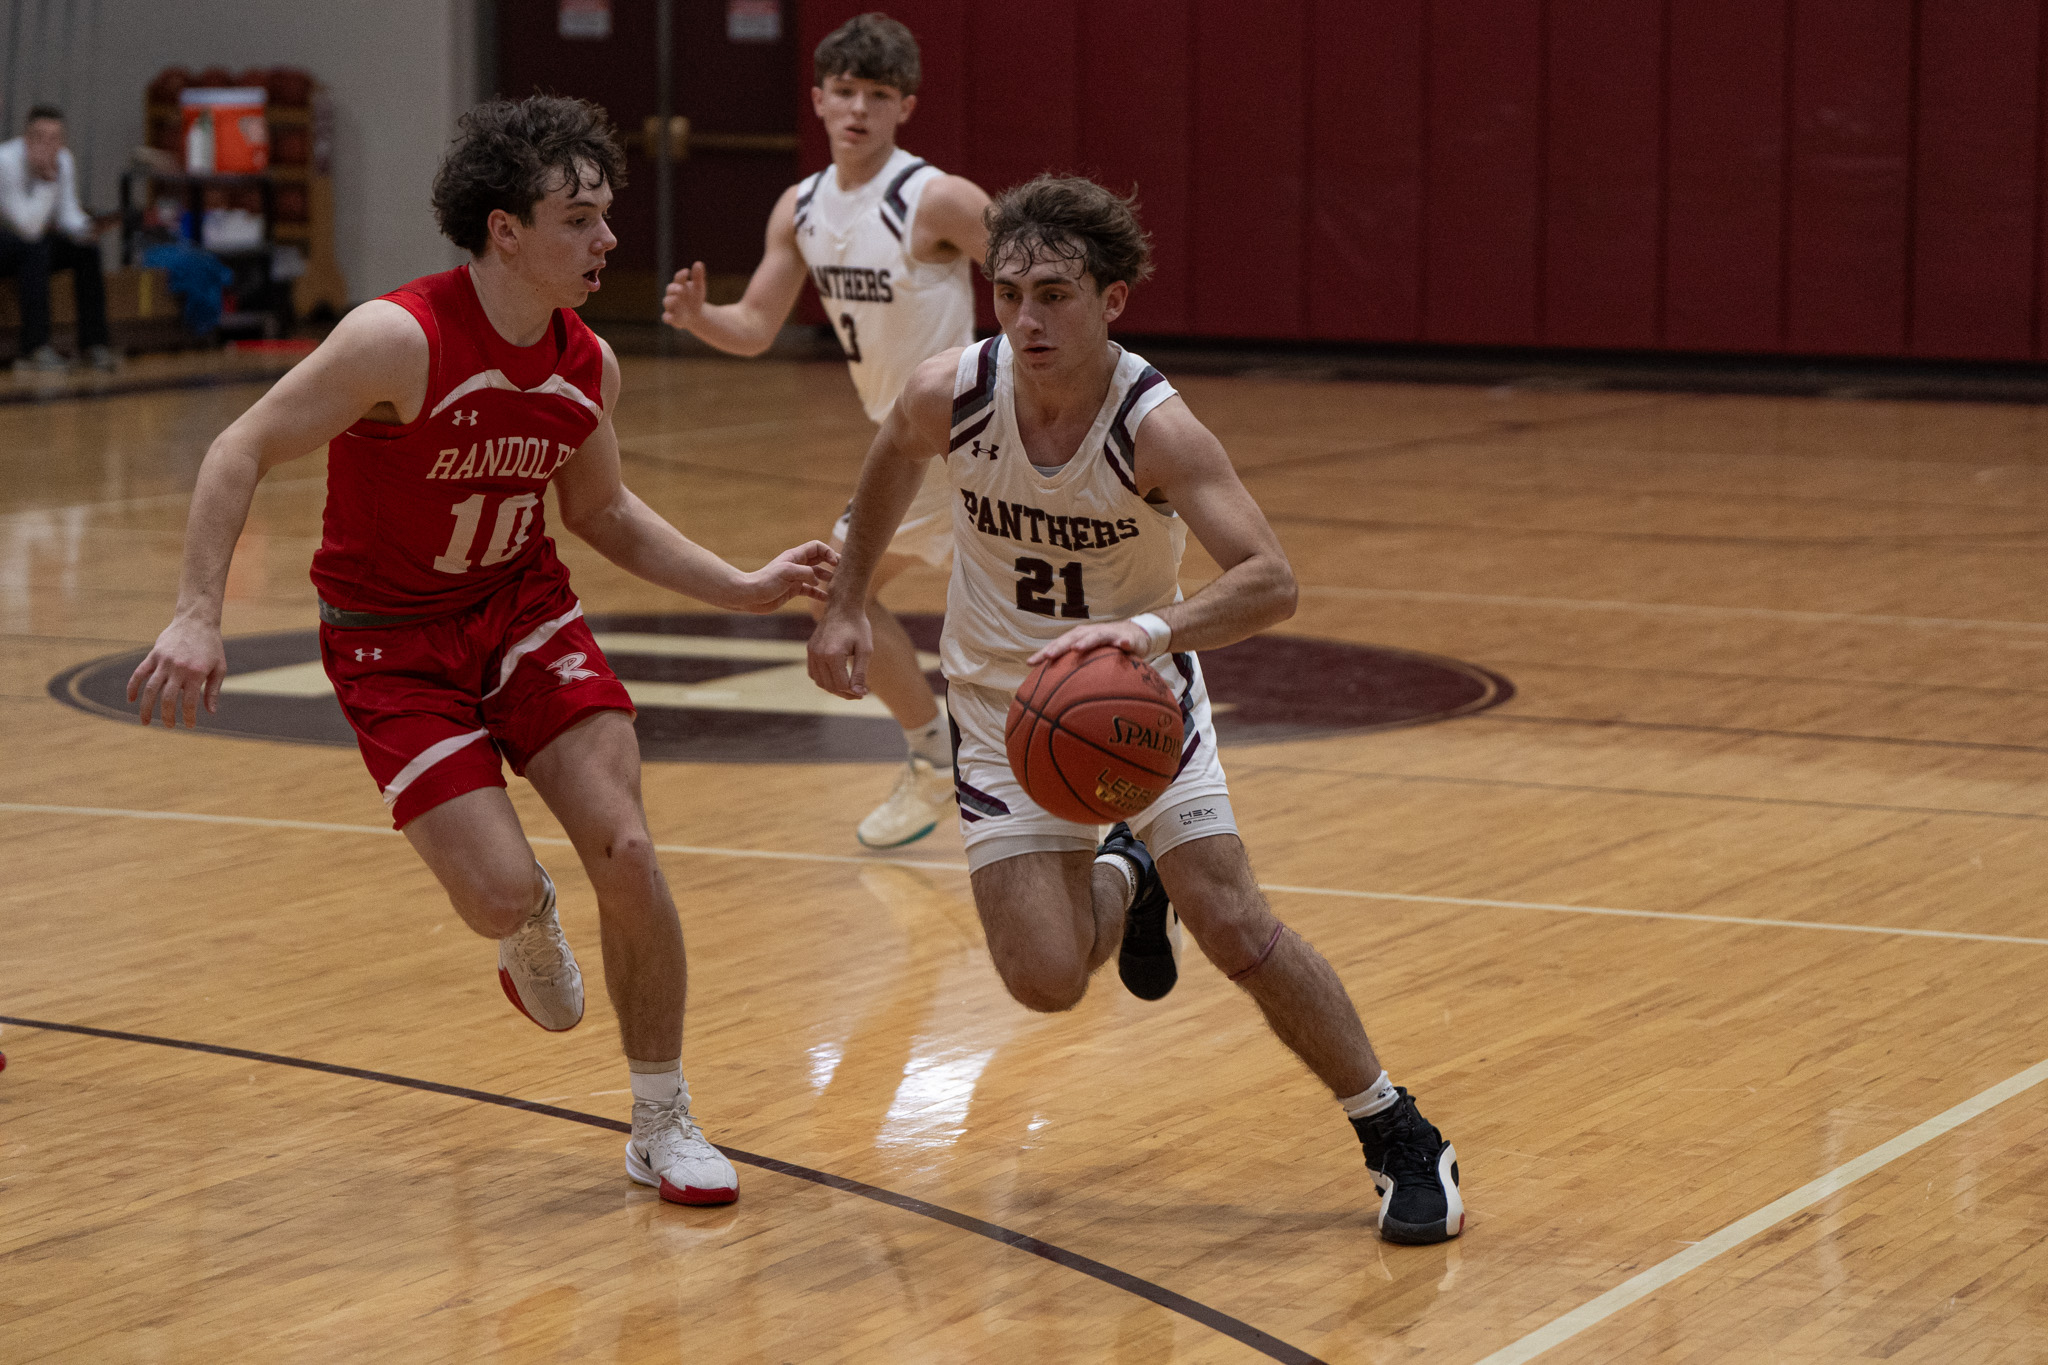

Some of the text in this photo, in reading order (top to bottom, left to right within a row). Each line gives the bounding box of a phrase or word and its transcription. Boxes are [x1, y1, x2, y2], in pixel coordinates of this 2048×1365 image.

[433, 492, 539, 574] 10
[960, 487, 1140, 552] PANTHERS
[1013, 556, 1090, 619] 21
[1179, 808, 1215, 820] HEX
